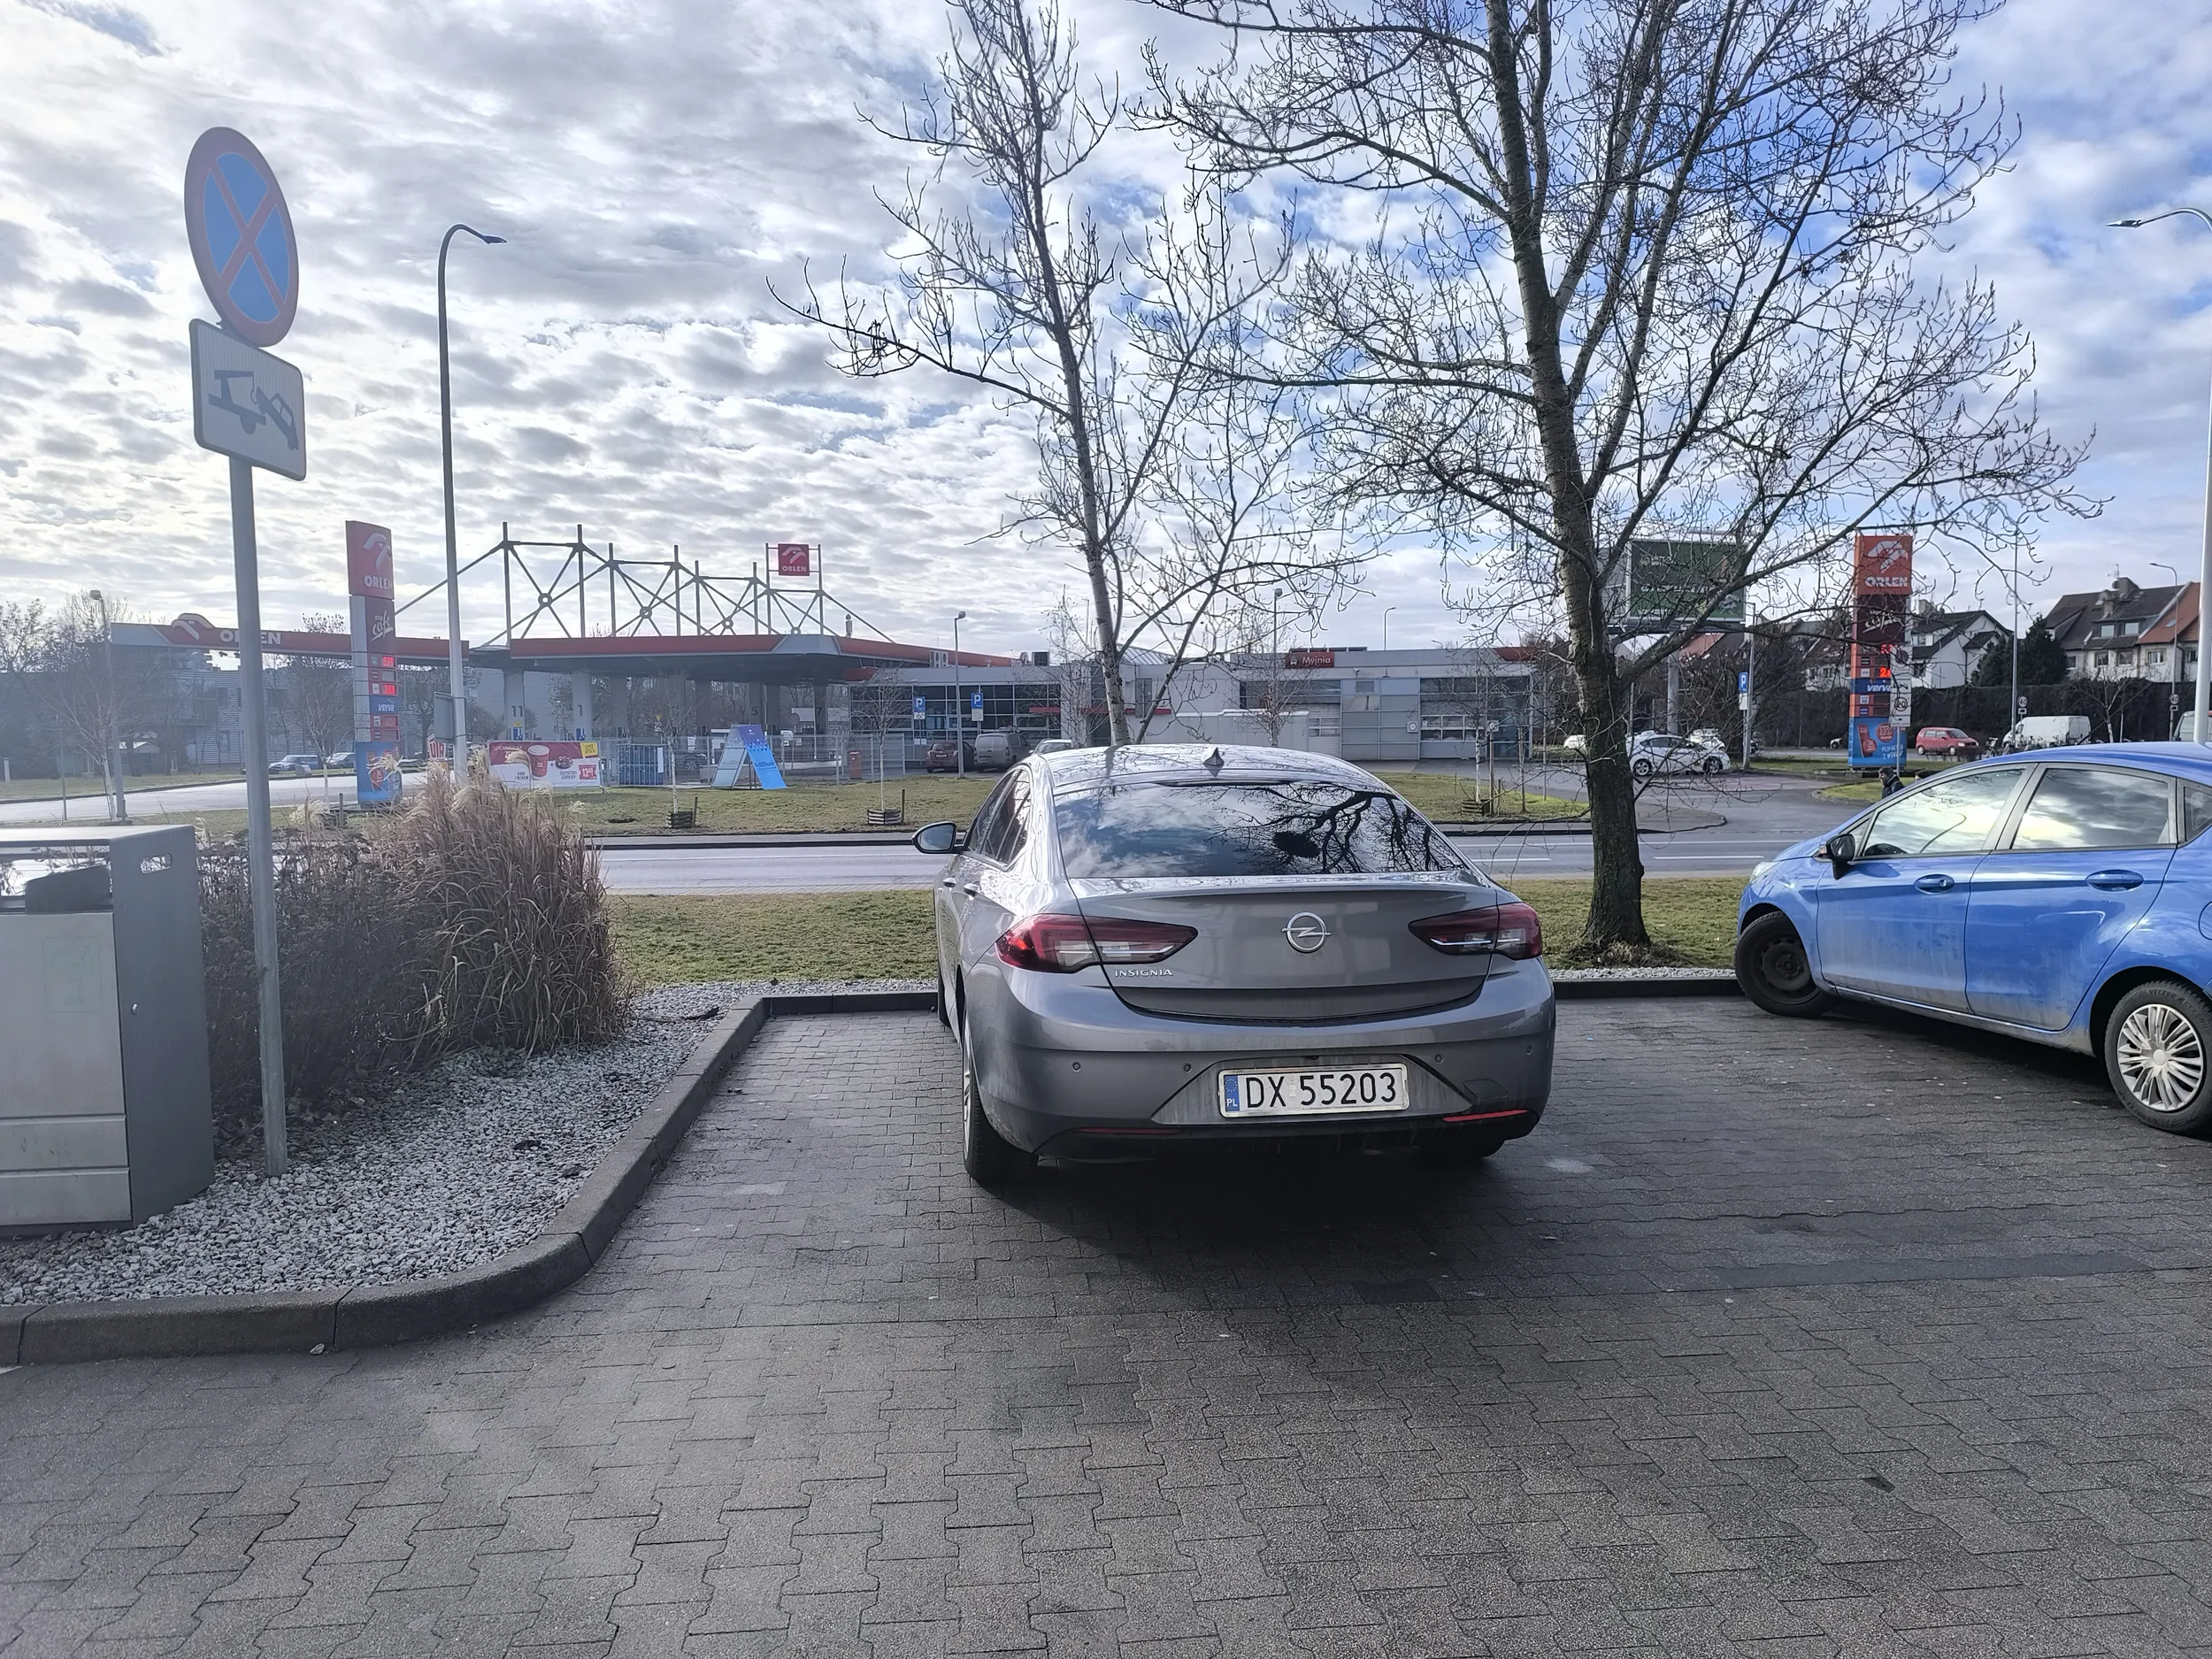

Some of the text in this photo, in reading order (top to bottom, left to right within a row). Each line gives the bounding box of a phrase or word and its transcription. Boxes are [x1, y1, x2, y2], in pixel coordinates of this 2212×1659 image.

[364, 574, 393, 591] ORLEN
[1864, 576, 1908, 588] ORLEN
[1302, 656, 1331, 665] Myjnia
[1741, 674, 1747, 688] P
[916, 698, 923, 708] P
[974, 695, 981, 704] P
[511, 705, 523, 717] 11
[578, 704, 583, 716] 1
[2149, 990, 2177, 999] VECTOR
[1246, 1072, 1396, 1108] DX 55203
[1226, 1098, 1238, 1107] PL
